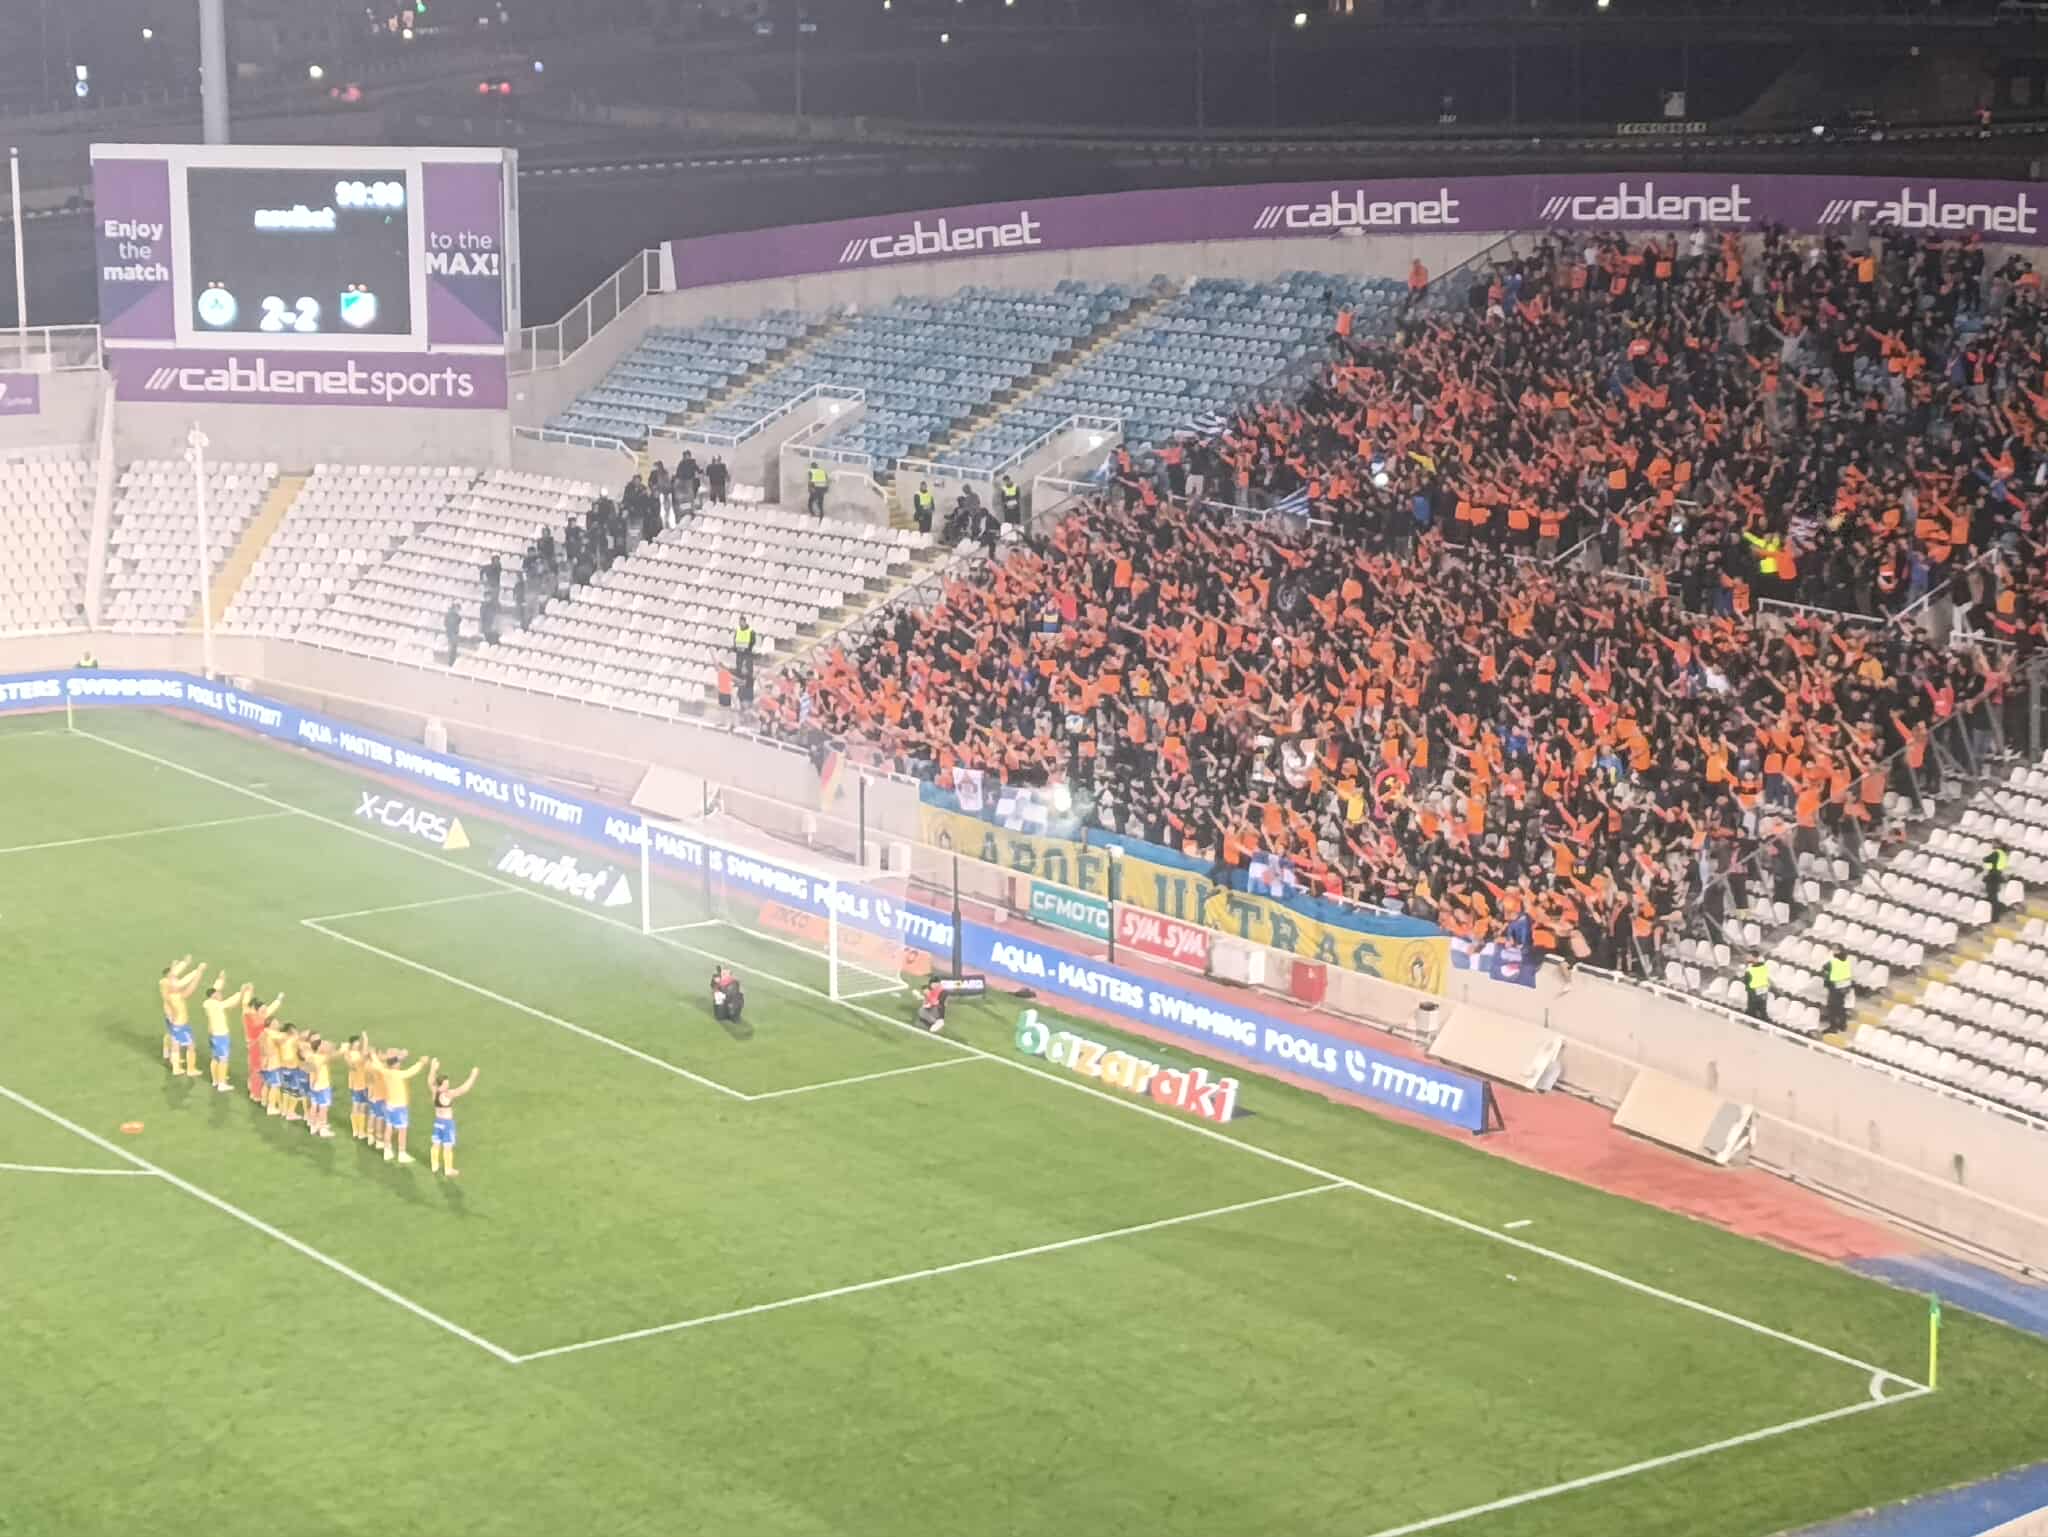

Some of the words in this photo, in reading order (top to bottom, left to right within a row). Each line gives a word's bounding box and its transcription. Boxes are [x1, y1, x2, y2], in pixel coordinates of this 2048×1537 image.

[1286, 188, 1459, 228] cablenet
[1572, 182, 1750, 222] cablenet
[1852, 187, 2037, 233] cablenet
[104, 219, 163, 241] Enjoy
[119, 241, 152, 259] the
[430, 231, 452, 249] to
[459, 229, 492, 249] the
[870, 211, 1041, 259] cablenet
[103, 262, 169, 281] match
[425, 251, 499, 276] MAX!
[67, 678, 182, 699] SWIMMING
[187, 685, 223, 710] POOLS
[298, 719, 332, 745] AQUA
[340, 731, 392, 765] MASTERS
[395, 748, 462, 787] SWIMMING
[465, 771, 509, 802] POOLS
[355, 791, 450, 843] X-CARS
[496, 846, 610, 901] novibet
[727, 851, 807, 900] SWIMMING
[1033, 889, 1110, 929] CFMOTO
[991, 941, 1045, 977] AQUA
[1058, 960, 1144, 1009] MASTERS
[1149, 991, 1257, 1046] SWIMMING
[1264, 1028, 1337, 1073] POOLS
[1016, 1008, 1239, 1123] bazaraki
